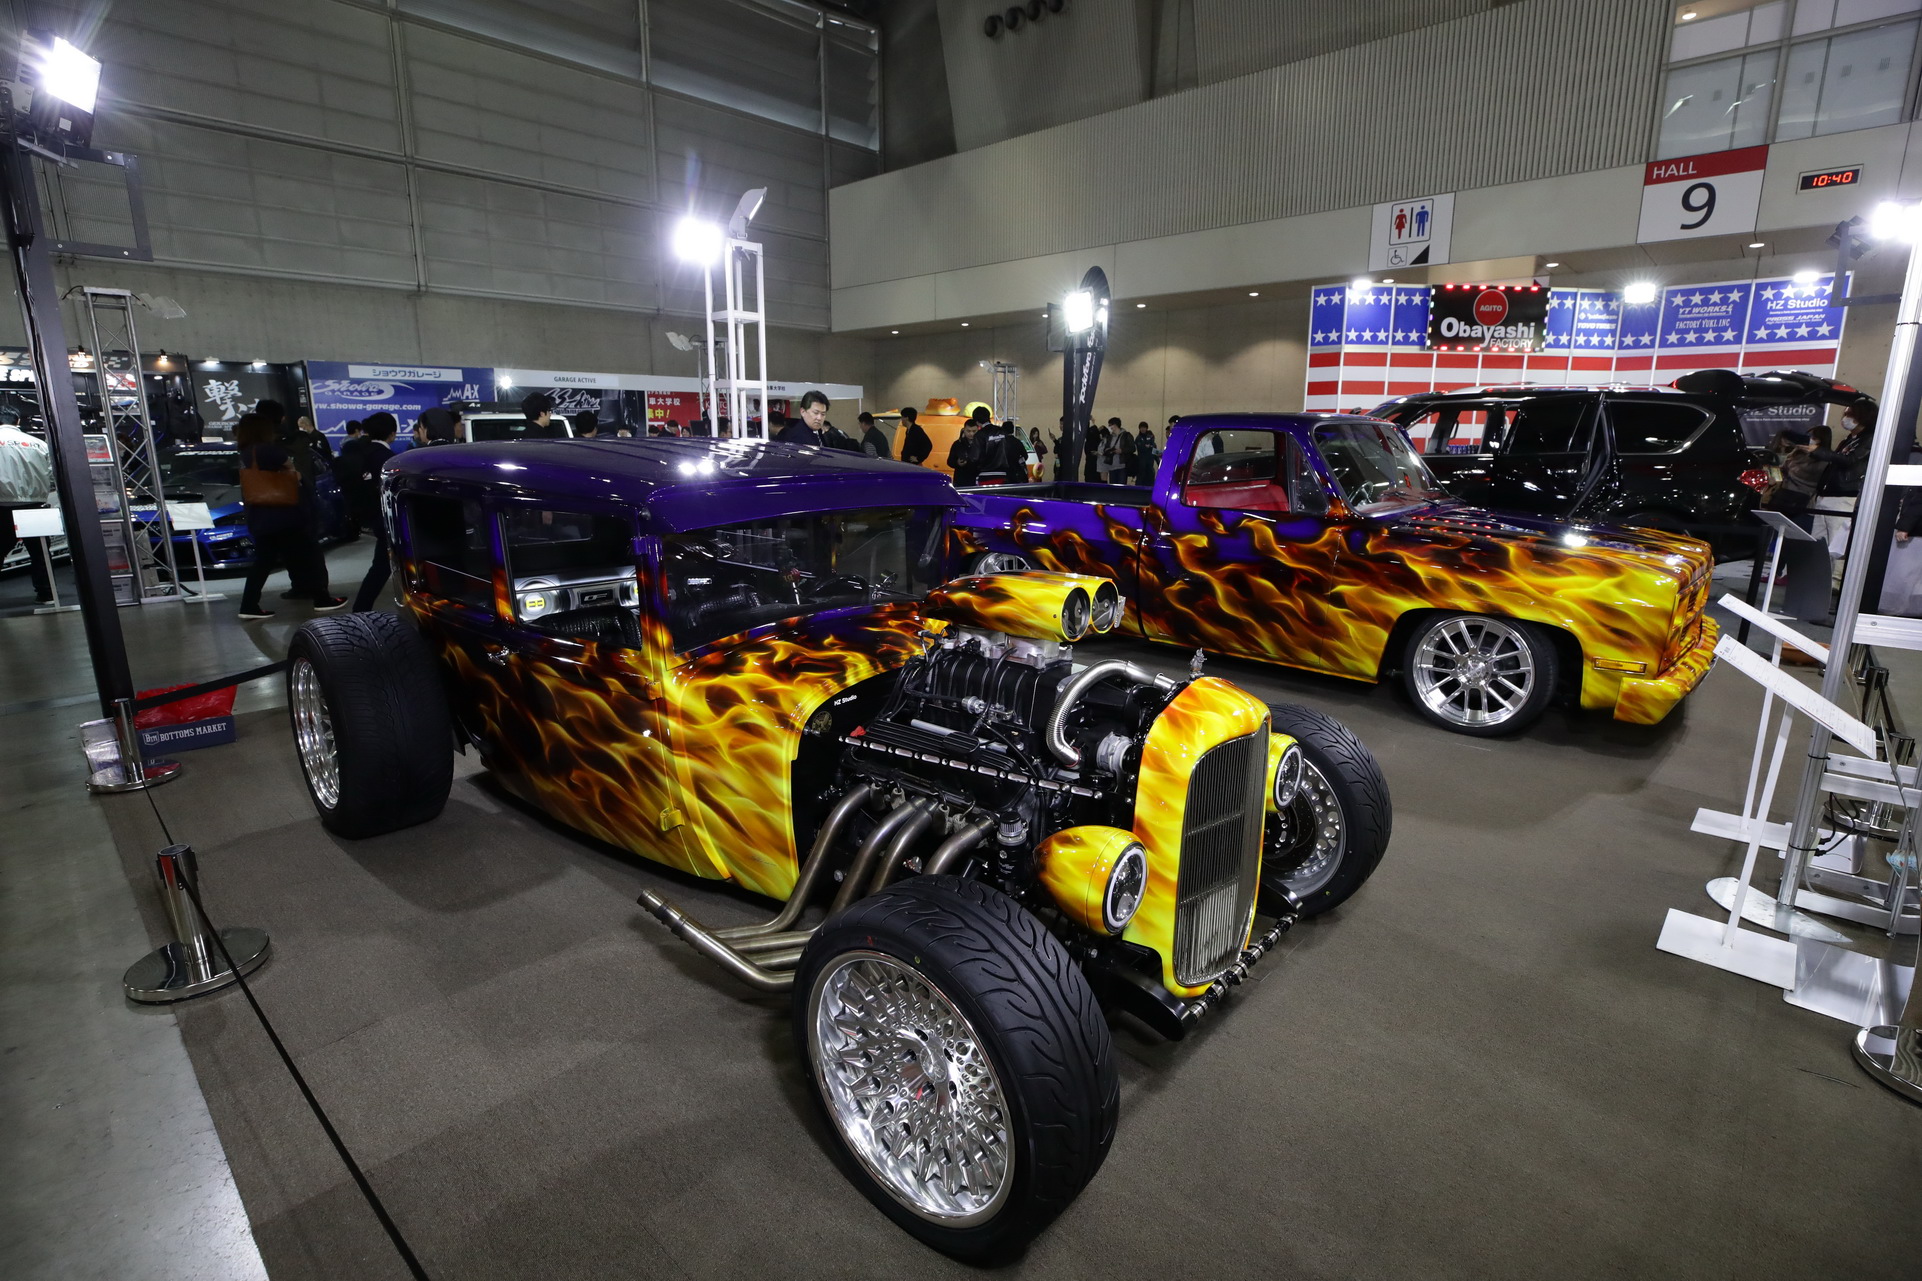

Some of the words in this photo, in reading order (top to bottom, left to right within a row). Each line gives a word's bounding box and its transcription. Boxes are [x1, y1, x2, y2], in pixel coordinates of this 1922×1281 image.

[1652, 161, 1697, 180] HALL
[1812, 170, 1853, 187] 10:40
[1679, 182, 1717, 230] 9
[1479, 304, 1503, 312] AGITO
[1692, 305, 1728, 313] WORKS
[1766, 300, 1785, 310] HZ
[1787, 298, 1829, 309] Studio
[1796, 313, 1826, 321] JAPAN
[1675, 319, 1701, 329] FACTORY
[1718, 318, 1731, 327] INC
[1440, 317, 1535, 348] Obayashi
[1489, 338, 1534, 348] FACTORY
[372, 369, 442, 378] ショウワガレージ
[1767, 404, 1816, 416] Studio
[159, 728, 195, 742] BOTTOMS
[195, 722, 227, 735] MARKET
